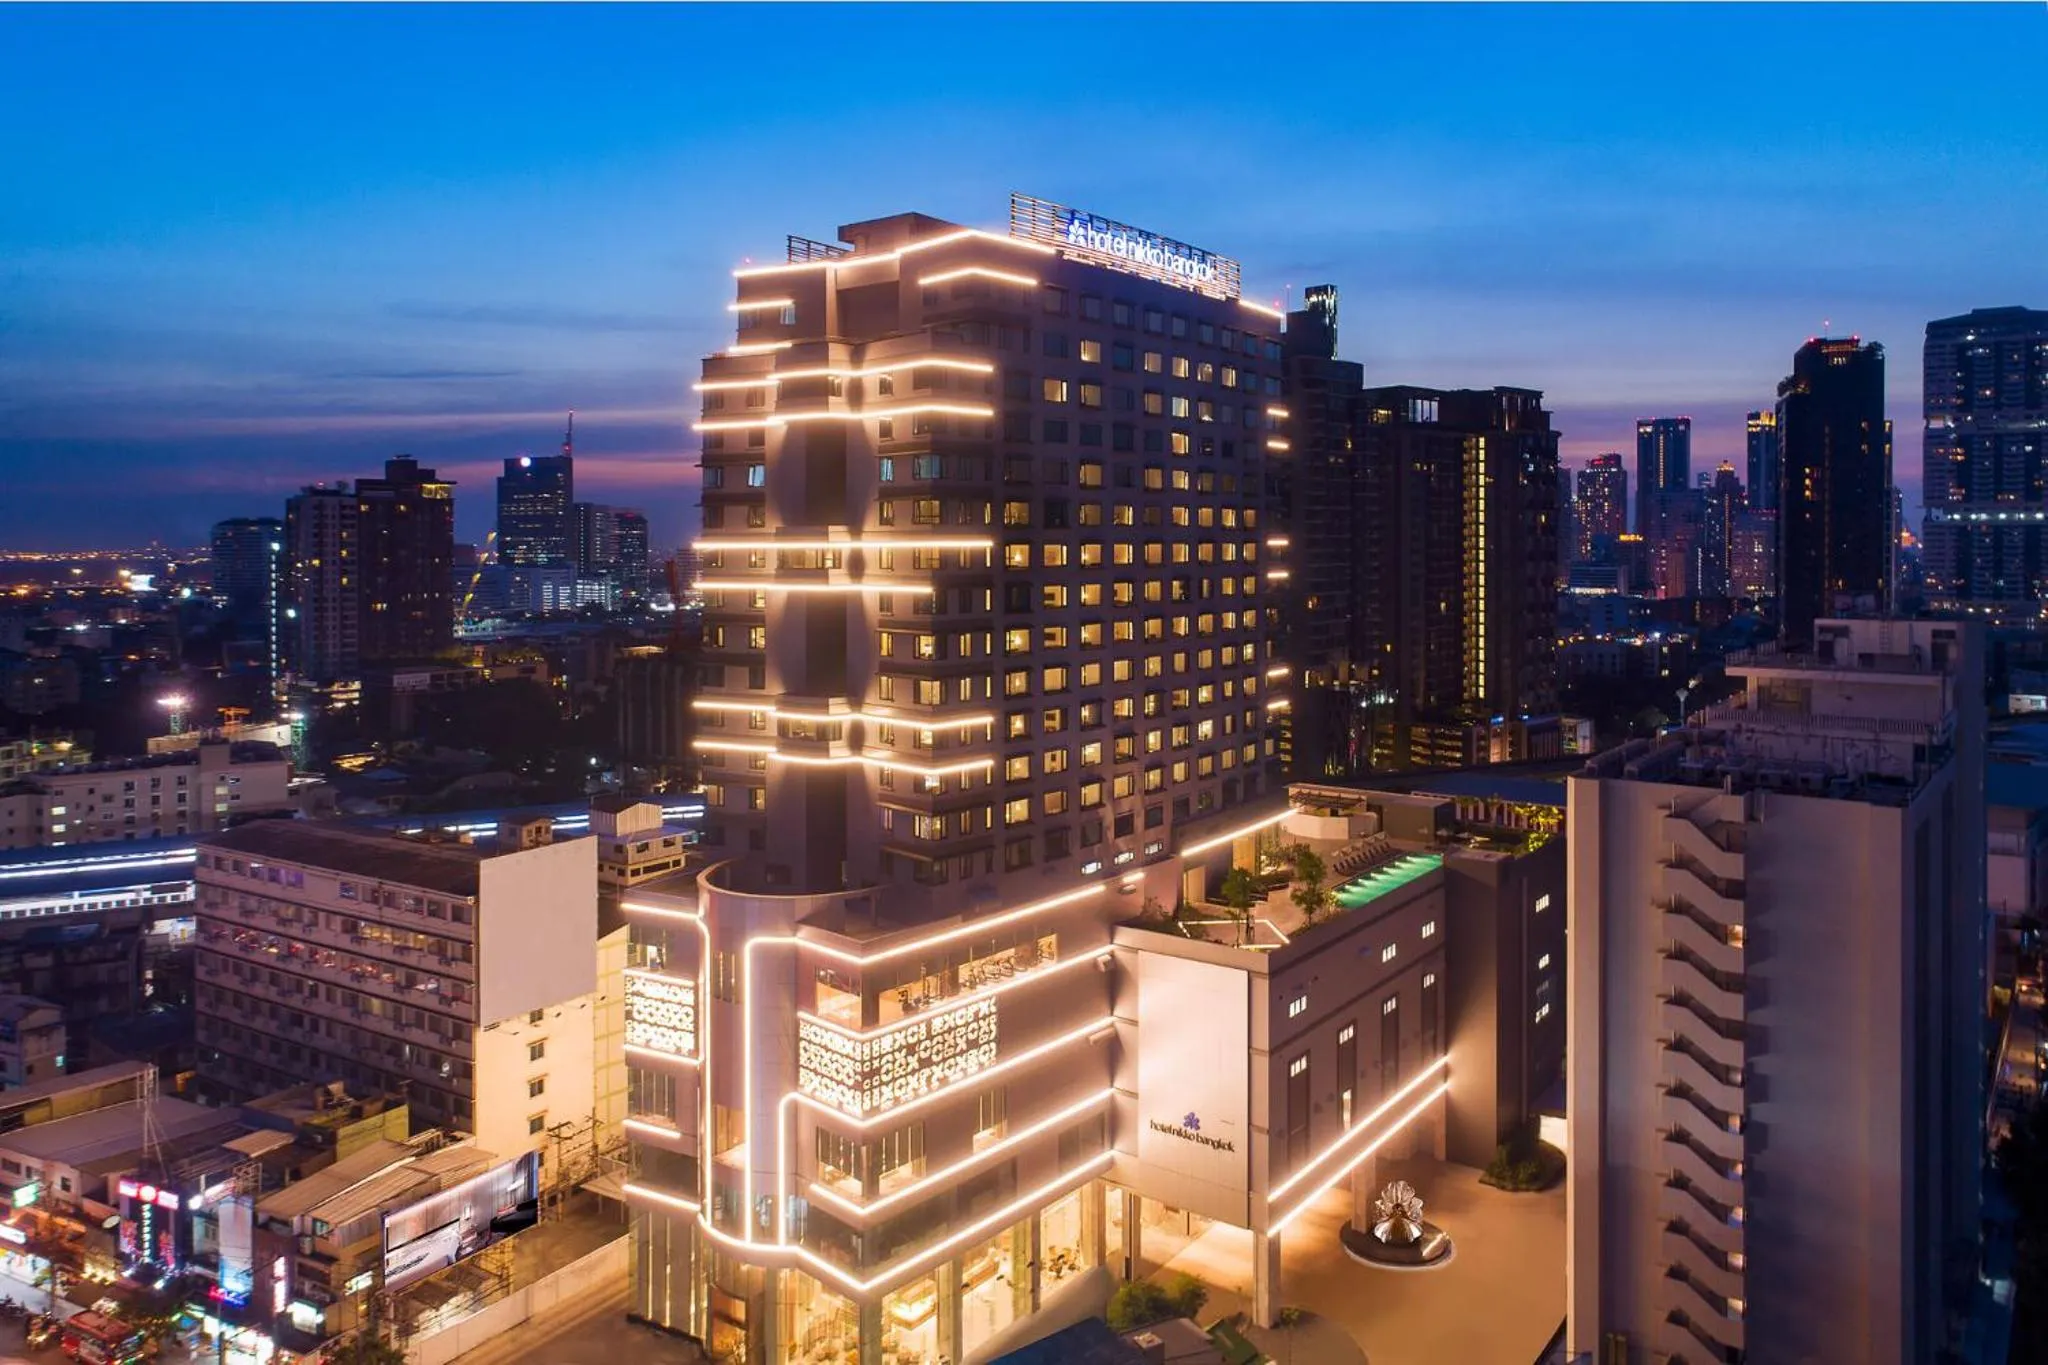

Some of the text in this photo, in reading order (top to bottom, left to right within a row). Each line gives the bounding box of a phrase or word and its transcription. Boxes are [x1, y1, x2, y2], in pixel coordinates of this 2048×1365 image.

[1087, 222, 1215, 283] hotel nikko bangkok
[1150, 1119, 1235, 1152] hotel nikko bangkok
